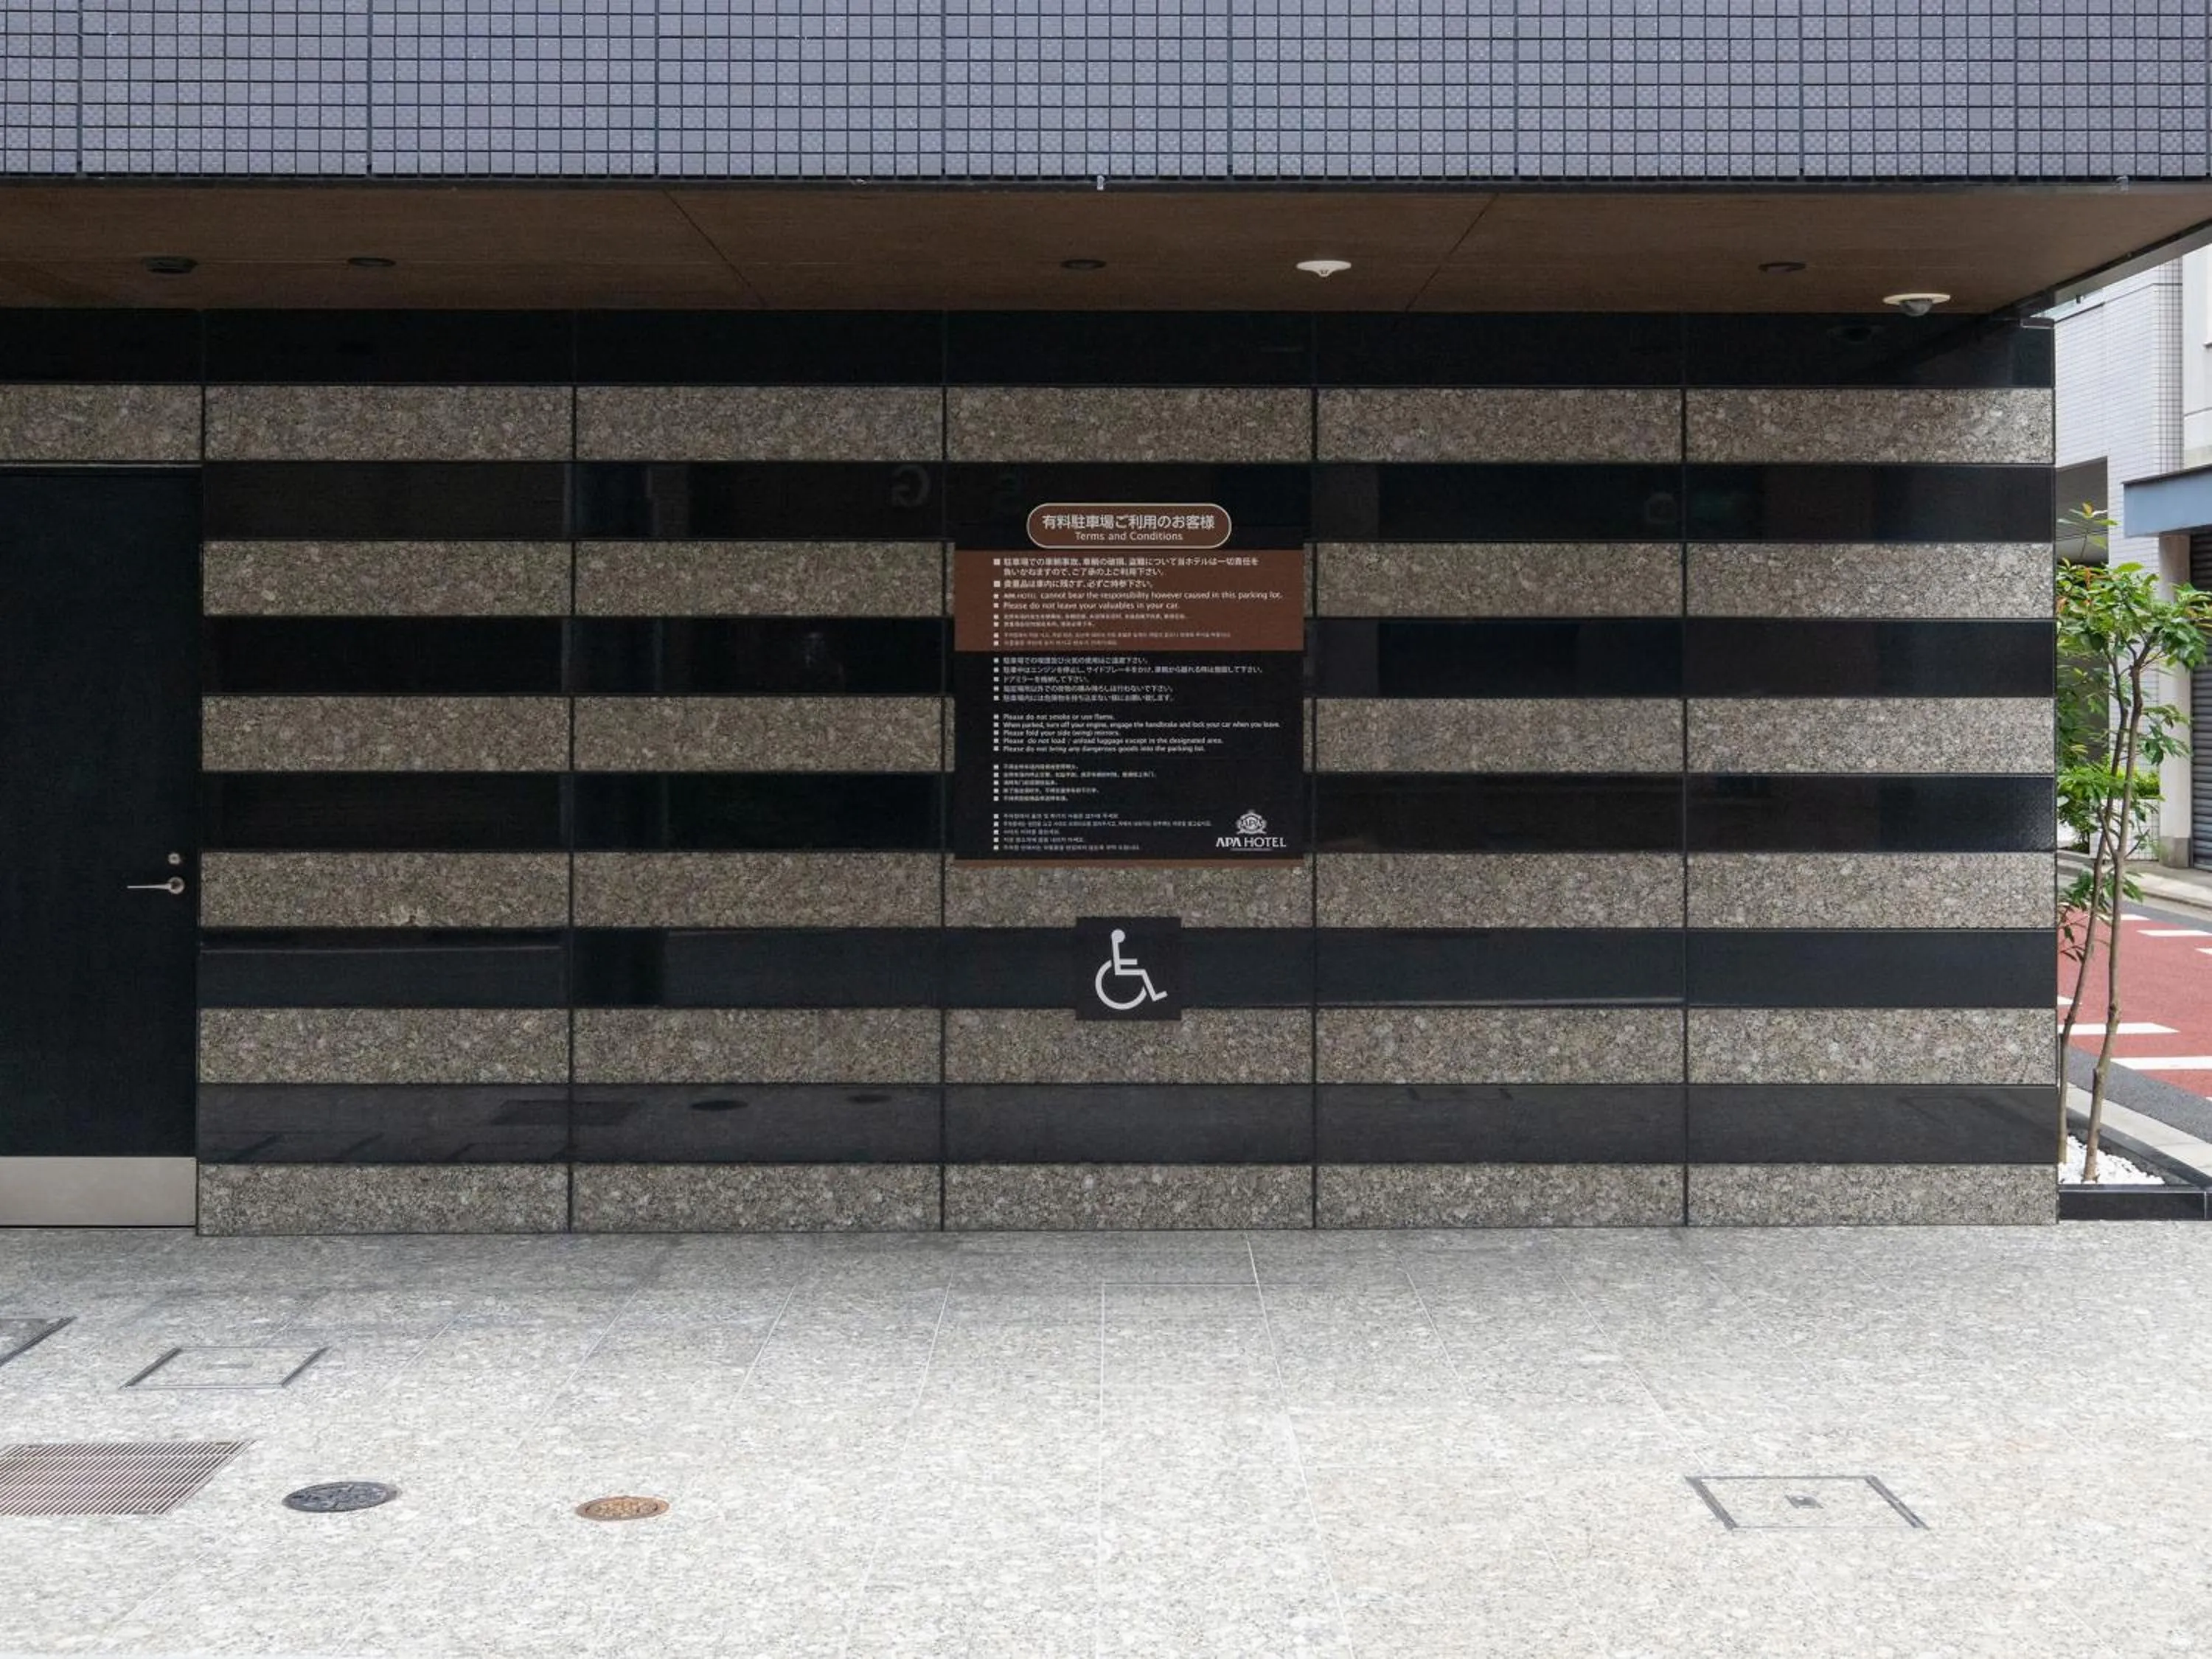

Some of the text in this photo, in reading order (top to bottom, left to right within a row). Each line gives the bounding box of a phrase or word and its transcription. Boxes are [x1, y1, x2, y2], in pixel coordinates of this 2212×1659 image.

[1042, 515, 1215, 530] 有料駐車場ご利用のお客様
[1076, 532, 1183, 541] Terms and Conditions
[1101, 592, 1149, 601] responsibility
[1239, 592, 1267, 601] parking
[1079, 602, 1096, 611] your
[1147, 602, 1164, 611] your
[1215, 837, 1287, 847] APA HOTEL
